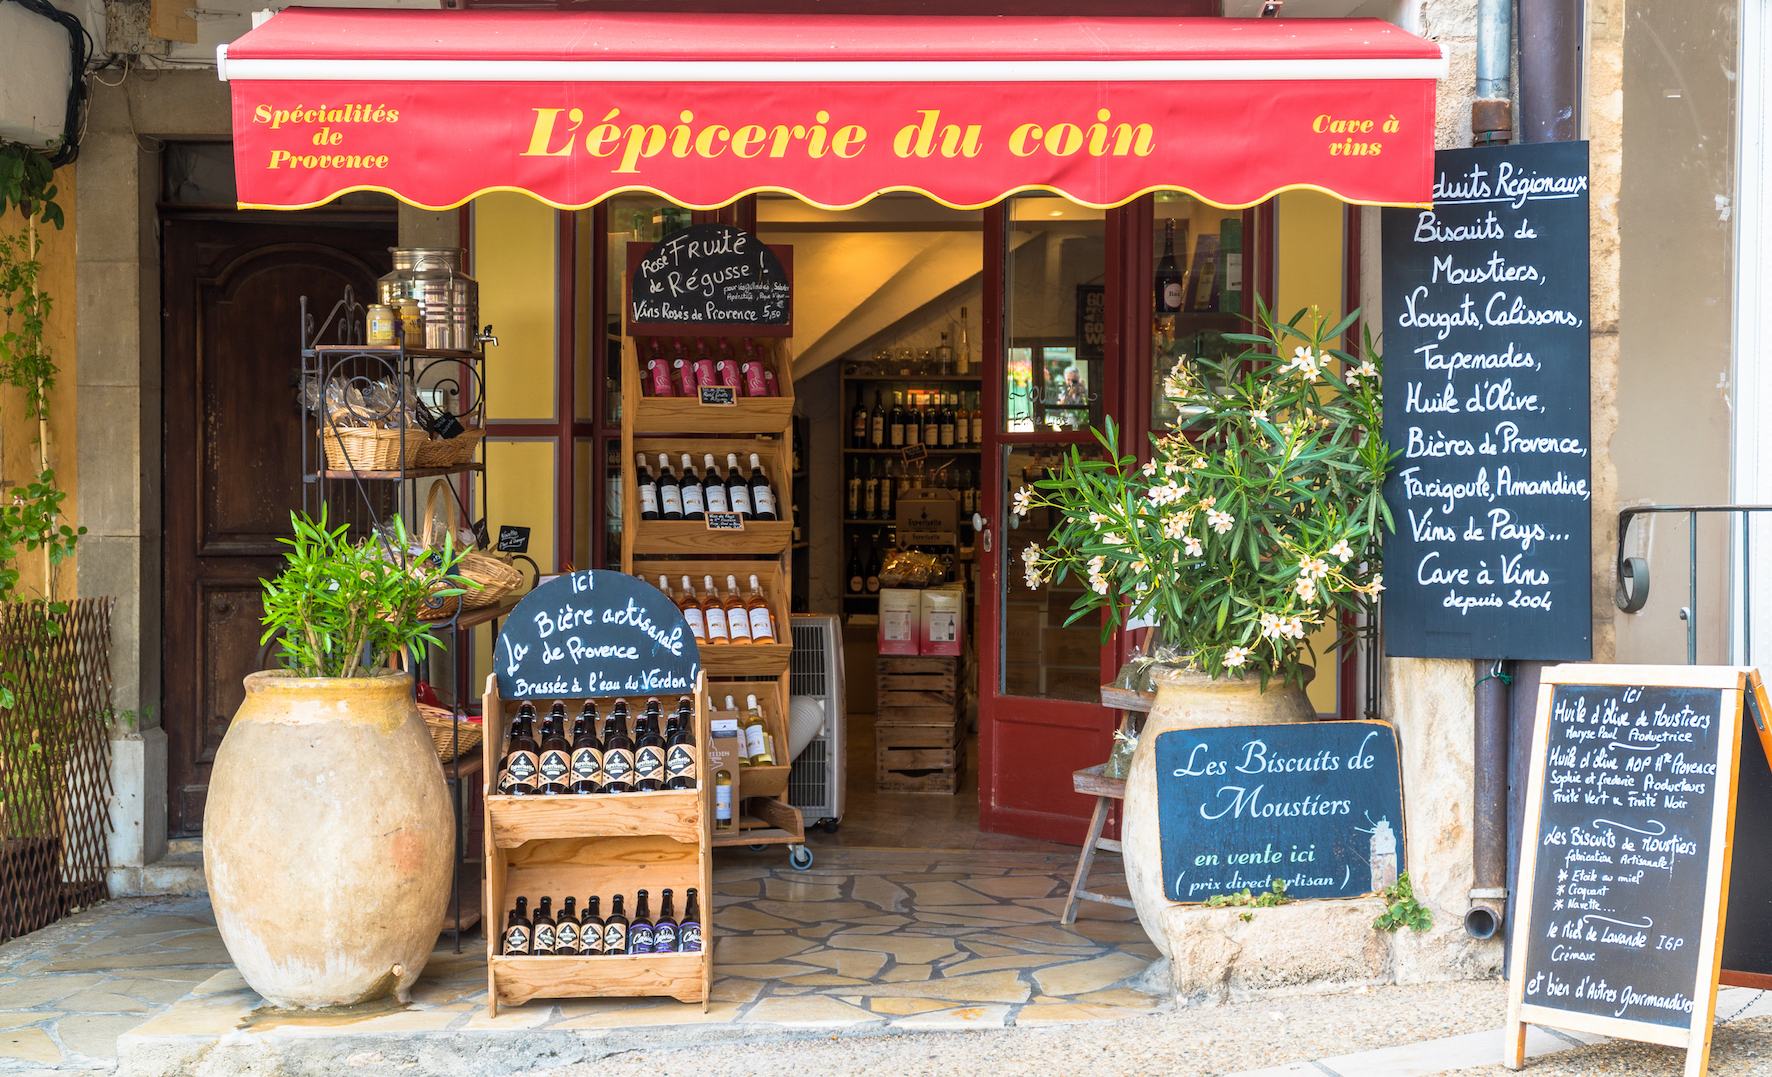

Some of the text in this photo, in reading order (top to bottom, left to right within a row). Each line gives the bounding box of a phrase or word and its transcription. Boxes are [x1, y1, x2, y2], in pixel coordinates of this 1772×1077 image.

[253, 104, 400, 126] Spécialités
[1312, 114, 1400, 135] Cave à
[311, 127, 343, 146] de
[520, 108, 1155, 174] L'épicerie du coin
[1328, 136, 1383, 157] vins
[267, 150, 389, 170] Provence
[1433, 162, 1587, 209] duits Régionaux
[1414, 211, 1537, 242] Biscuits de
[650, 279, 664, 293] de
[668, 264, 750, 297] Régusse
[1432, 251, 1545, 285] Moustiers,
[632, 299, 660, 321] Vins
[662, 302, 689, 320] Rosés
[691, 308, 703, 321] de
[706, 301, 758, 321] Provence
[1399, 286, 1582, 340] Nougats, Calissons,
[1085, 323, 1104, 333] GO
[1414, 342, 1542, 380] Tapenades,
[1405, 378, 1545, 413] Huile d'Olive,
[1406, 421, 1587, 458] Bières de Provence,
[1400, 465, 1590, 514] Farigoule, Amandine,
[1408, 507, 1456, 542] Vins
[1464, 516, 1484, 540] de
[1417, 551, 1549, 585] Cave à Vins
[571, 570, 594, 594] ici
[1443, 589, 1551, 615] depuis 2004
[534, 604, 596, 638] Bière
[602, 597, 684, 656] artisanale
[543, 636, 640, 665] de Provence
[514, 675, 569, 697] Brassée
[571, 678, 582, 693] à
[589, 671, 620, 692] l'eau
[625, 675, 639, 690] du
[1622, 686, 1645, 703] ici
[1555, 696, 1587, 723] Huile
[1635, 710, 1649, 727] de
[1653, 703, 1711, 729] Moustiers
[1598, 726, 1618, 740] Paul
[1628, 727, 1693, 742] Productrice
[1173, 731, 1378, 777] Les Biscuits de
[1549, 745, 1577, 769] Huile
[1671, 752, 1717, 776] Provence
[1585, 772, 1596, 785] et
[1644, 773, 1706, 795] Producteurs
[1200, 784, 1351, 820] Moustiers
[1664, 795, 1688, 809] Noir
[1570, 827, 1616, 848] Biscuits
[1621, 837, 1636, 852] de
[1642, 834, 1697, 855] Moustiers
[1194, 843, 1316, 867] en vente ici
[1226, 871, 1271, 890] direct
[1283, 876, 1334, 892] rtisan
[1618, 870, 1644, 884] miel
[1568, 884, 1610, 900] Croquant
[1585, 926, 1597, 941] de
[1600, 927, 1647, 948] Lavande
[1527, 970, 1545, 995] et
[1547, 972, 1570, 996] bien
